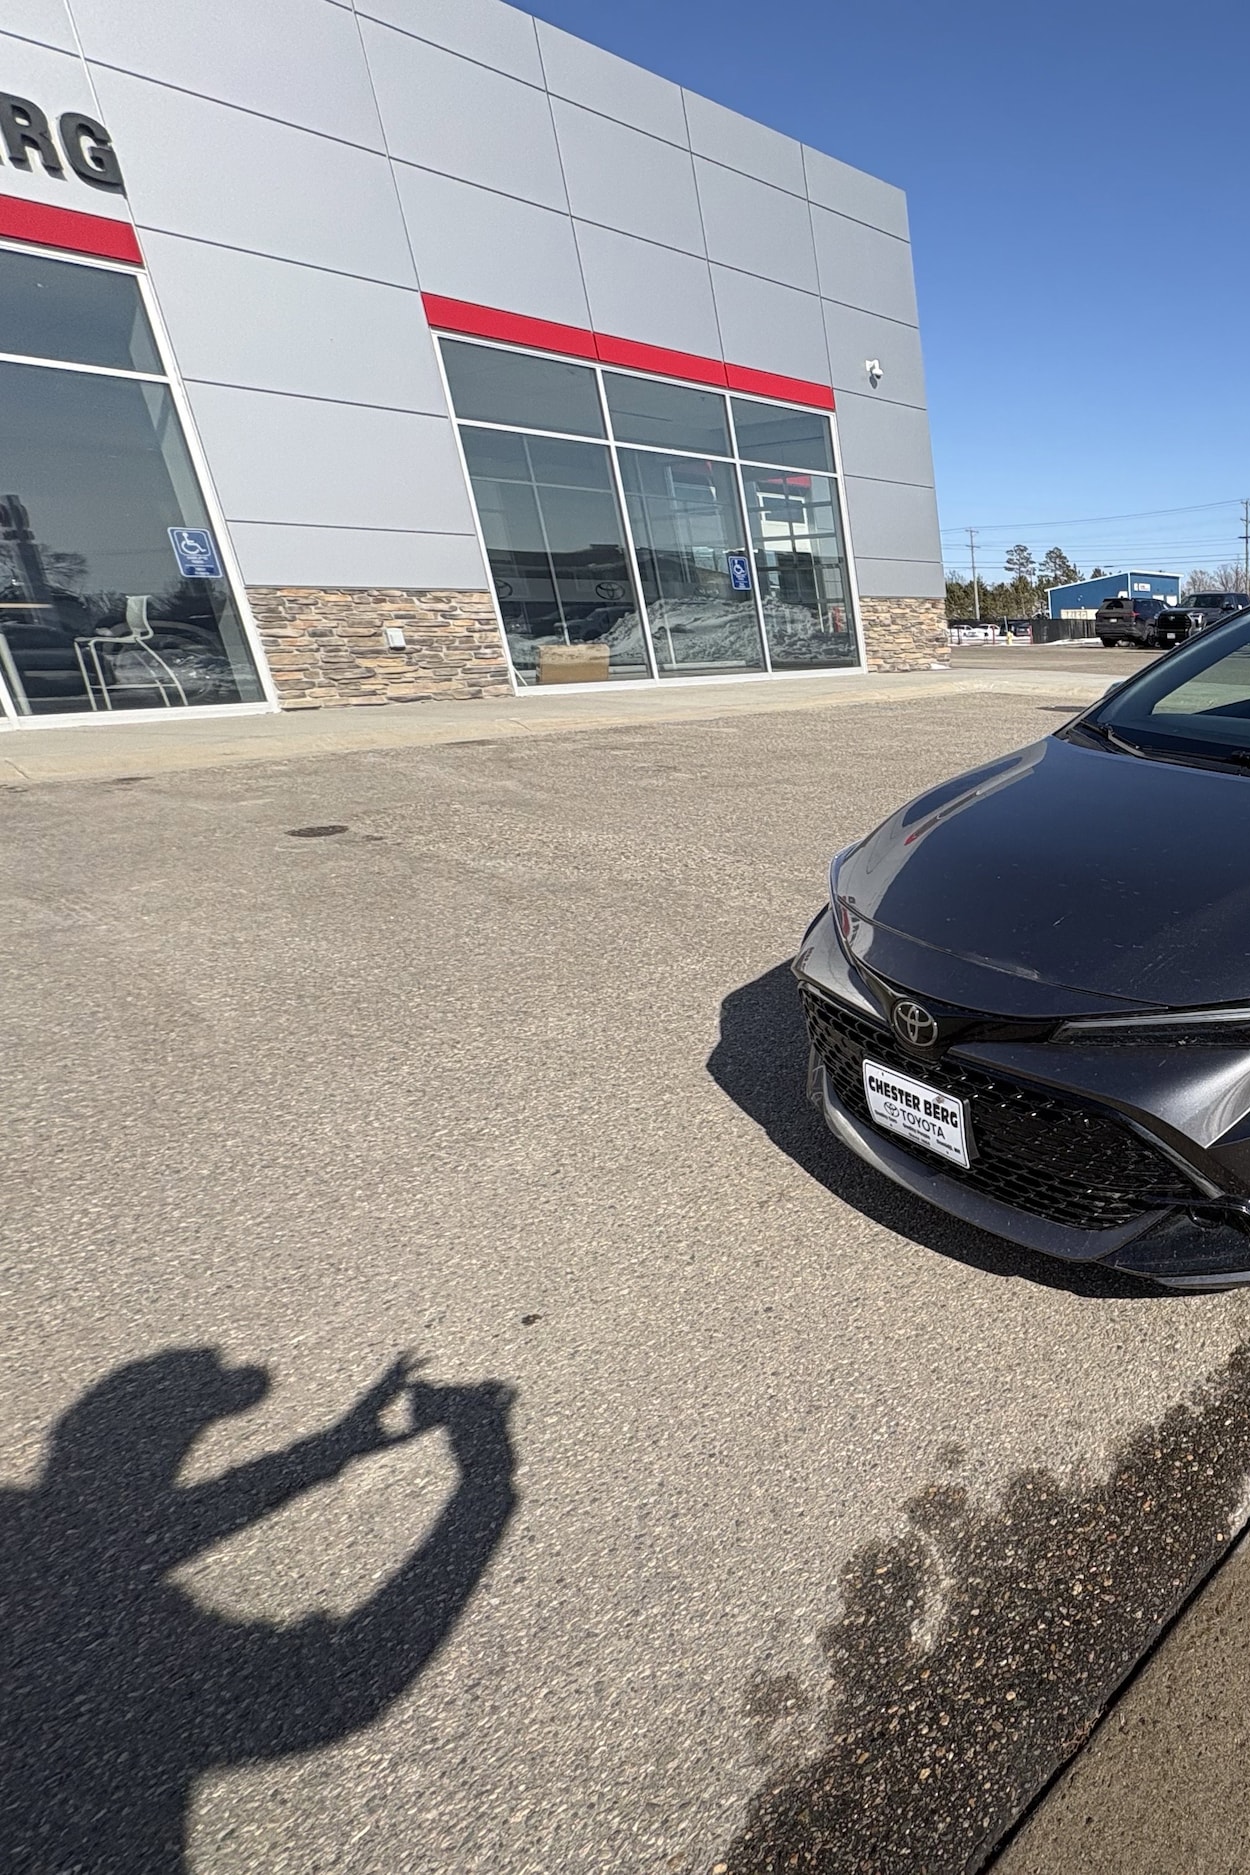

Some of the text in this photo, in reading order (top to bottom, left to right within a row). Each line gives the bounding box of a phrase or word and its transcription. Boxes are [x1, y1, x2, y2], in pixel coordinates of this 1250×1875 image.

[0, 91, 127, 200] RG
[868, 1075, 921, 1113] CHESTER
[924, 1099, 958, 1129] BERG
[900, 1108, 945, 1140] TOYOTA
